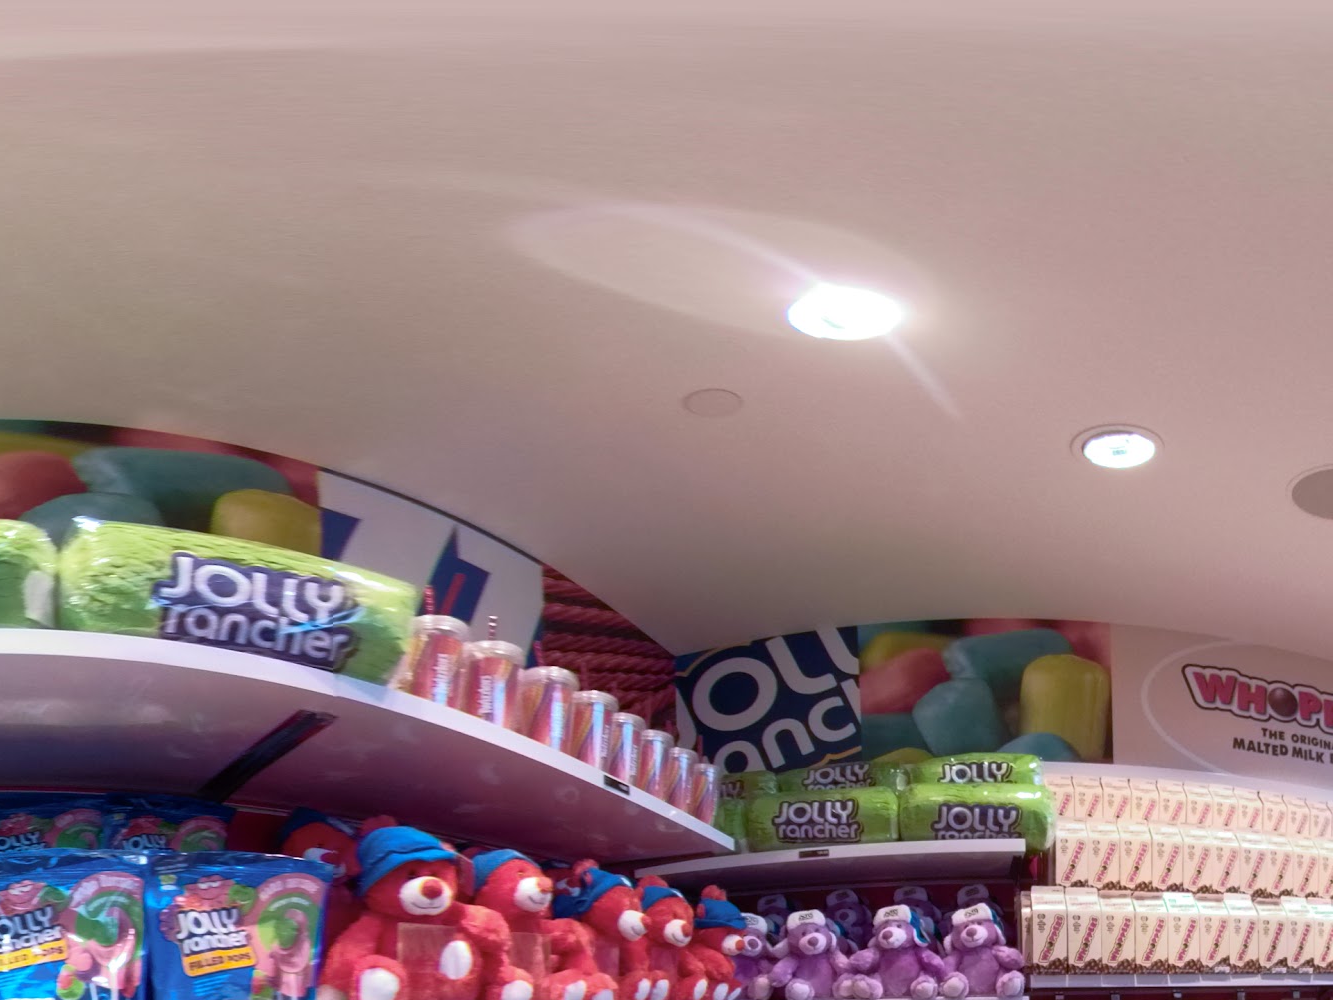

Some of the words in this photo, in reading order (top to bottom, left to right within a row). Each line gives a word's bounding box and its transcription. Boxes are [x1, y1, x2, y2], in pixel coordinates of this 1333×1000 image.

[160, 555, 345, 624] JOLLY
[1233, 737, 1288, 757] MALTED
[1292, 746, 1325, 764] MILK
[1261, 727, 1285, 741] THE
[1291, 733, 1333, 750] ORIGIN
[804, 763, 870, 784] JOLLY
[941, 761, 1011, 784] JOLLY
[774, 800, 853, 825] JOLLY
[934, 806, 1019, 832] JOLLY
[778, 821, 861, 840] rancher
[176, 907, 241, 938] JOLLY
[1040, 915, 1063, 961] WHOPPERS
[1076, 917, 1098, 961] WHOPPERS
